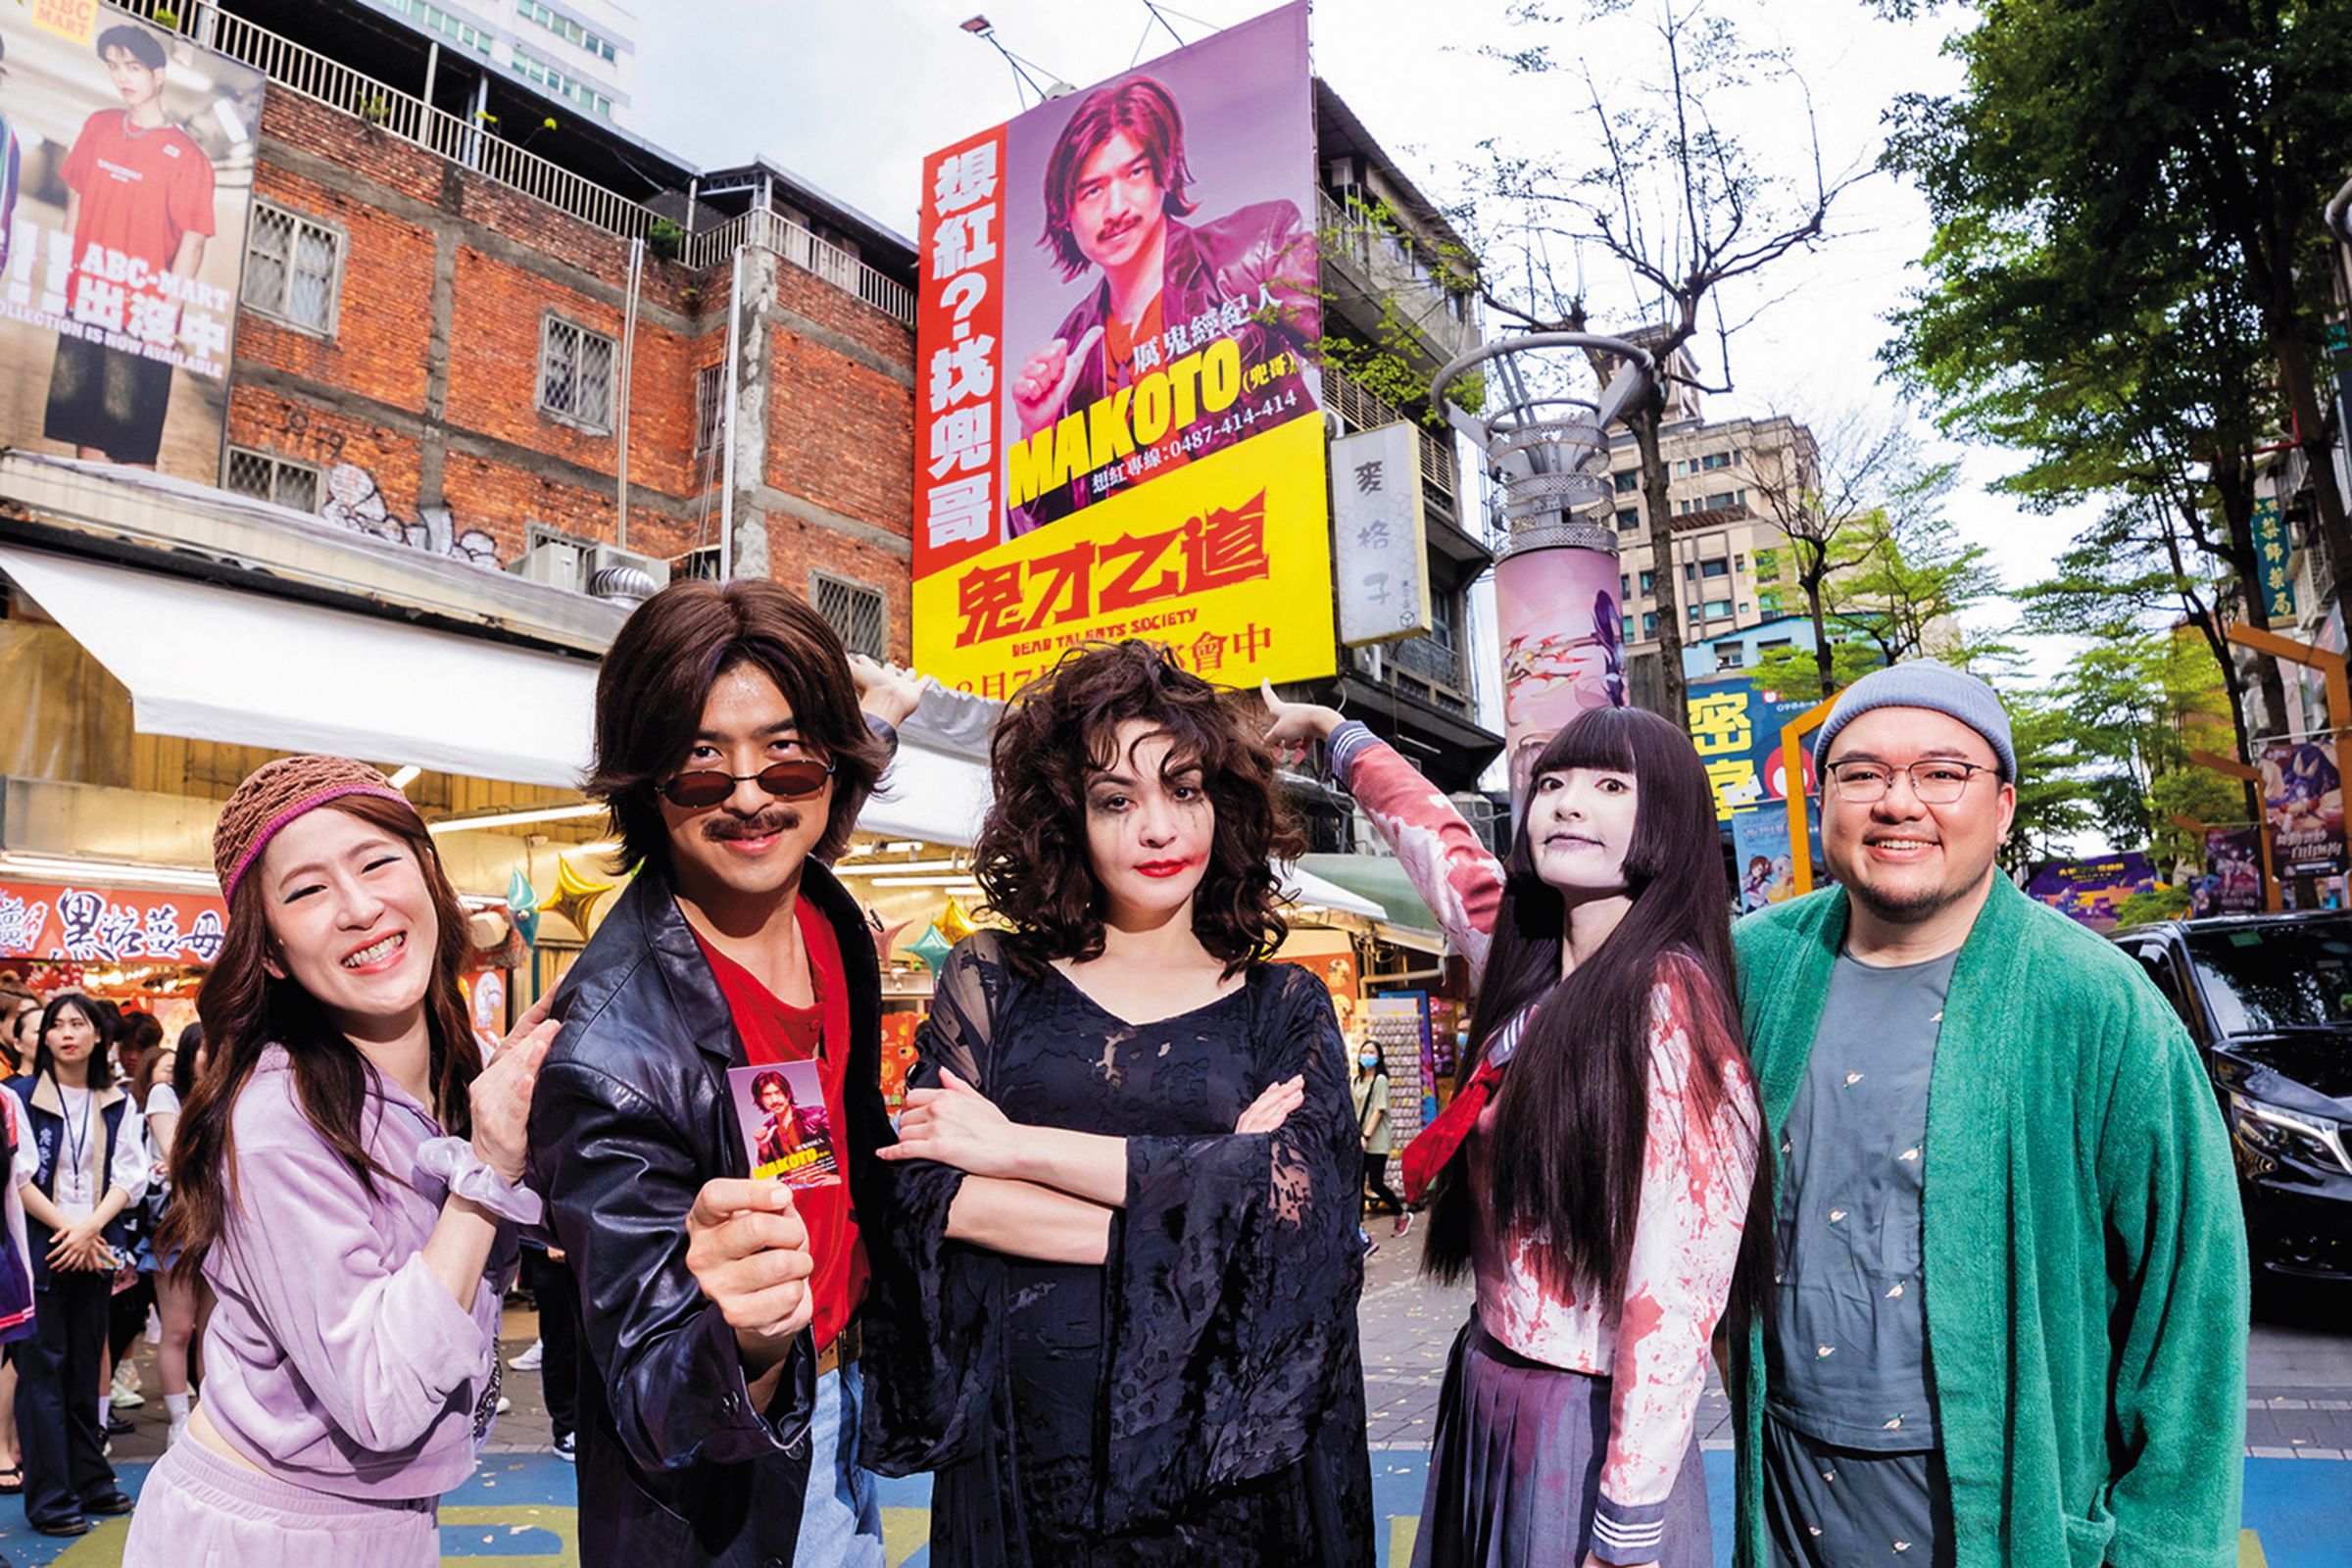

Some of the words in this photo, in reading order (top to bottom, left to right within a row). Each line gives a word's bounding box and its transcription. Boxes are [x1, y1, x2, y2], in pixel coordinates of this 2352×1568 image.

[37, 6, 89, 37] MART
[79, 241, 230, 313] ABC-MART
[85, 325, 104, 345] IS
[104, 331, 145, 356] NOW
[142, 343, 223, 379] AVAILABLE
[1008, 338, 1241, 511] MAKOTO
[954, 486, 1270, 649] 鬼才之道
[1011, 638, 1053, 659] DEAD
[1130, 607, 1198, 634] SOCIETY
